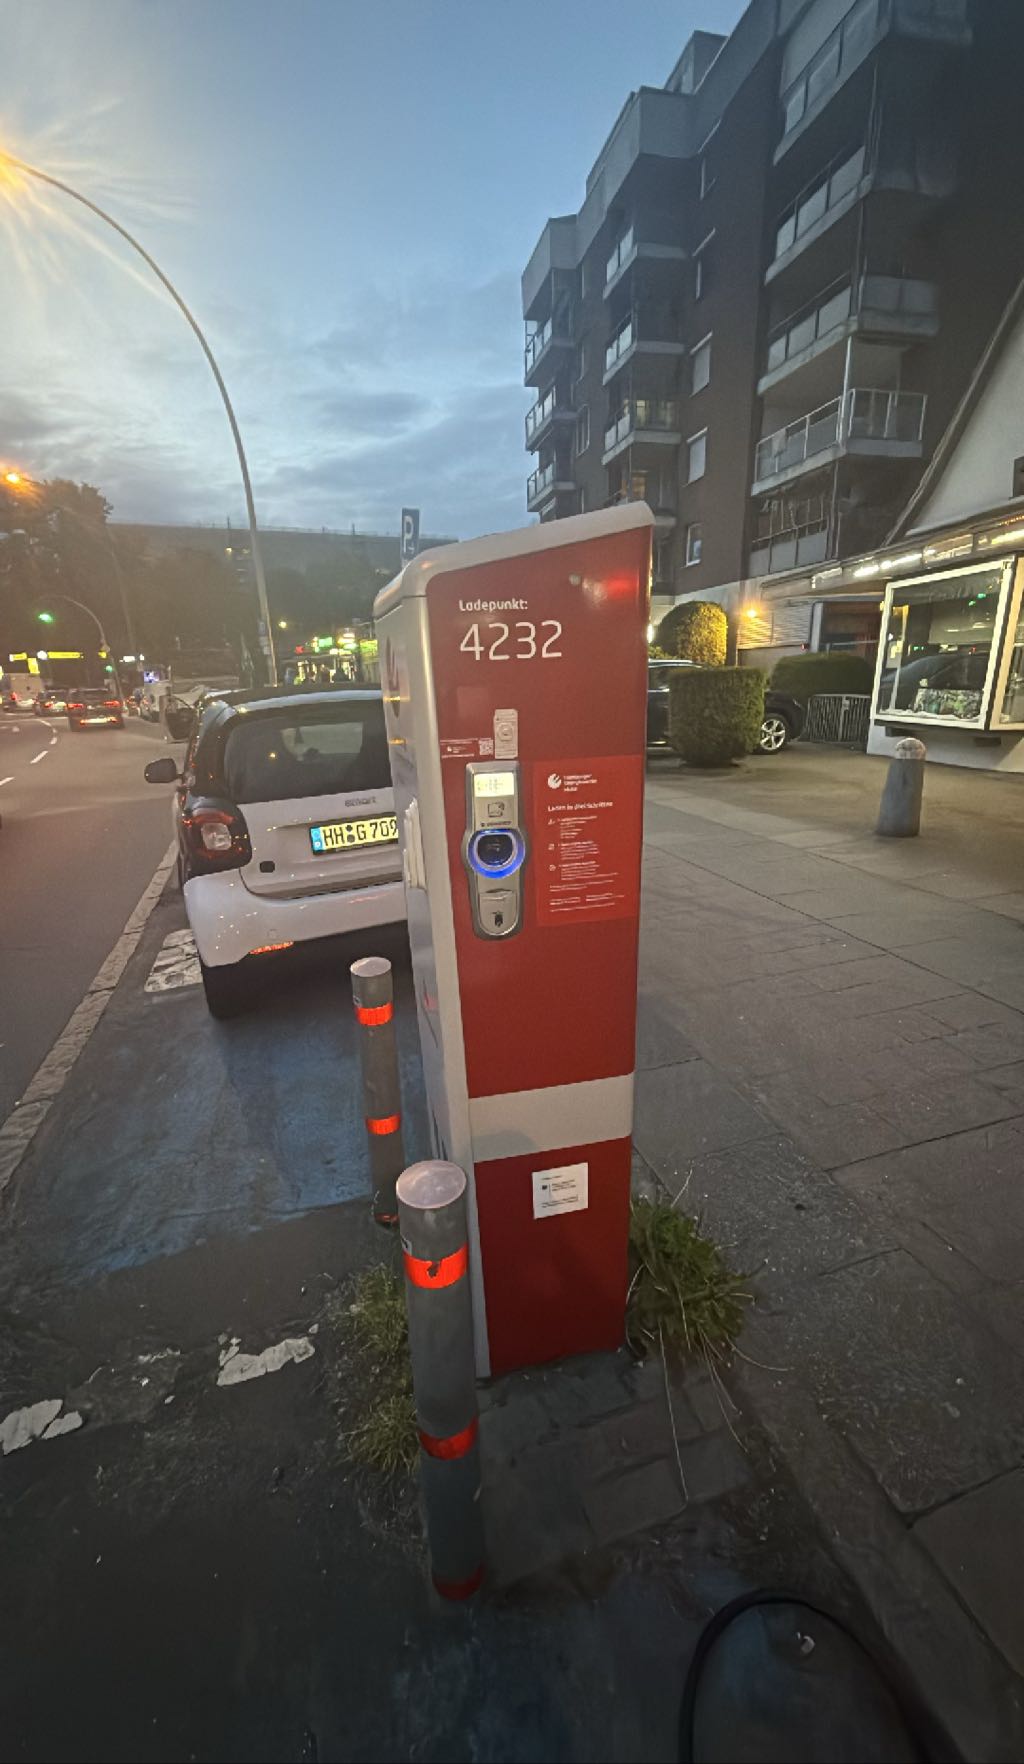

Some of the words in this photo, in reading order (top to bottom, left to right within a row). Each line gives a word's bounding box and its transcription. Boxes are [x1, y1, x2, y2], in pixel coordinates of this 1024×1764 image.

[403, 515, 414, 553] P
[458, 598, 528, 612] Ladepunkt:
[460, 619, 562, 661] 4232
[323, 826, 345, 847] HH
[356, 824, 366, 841] G
